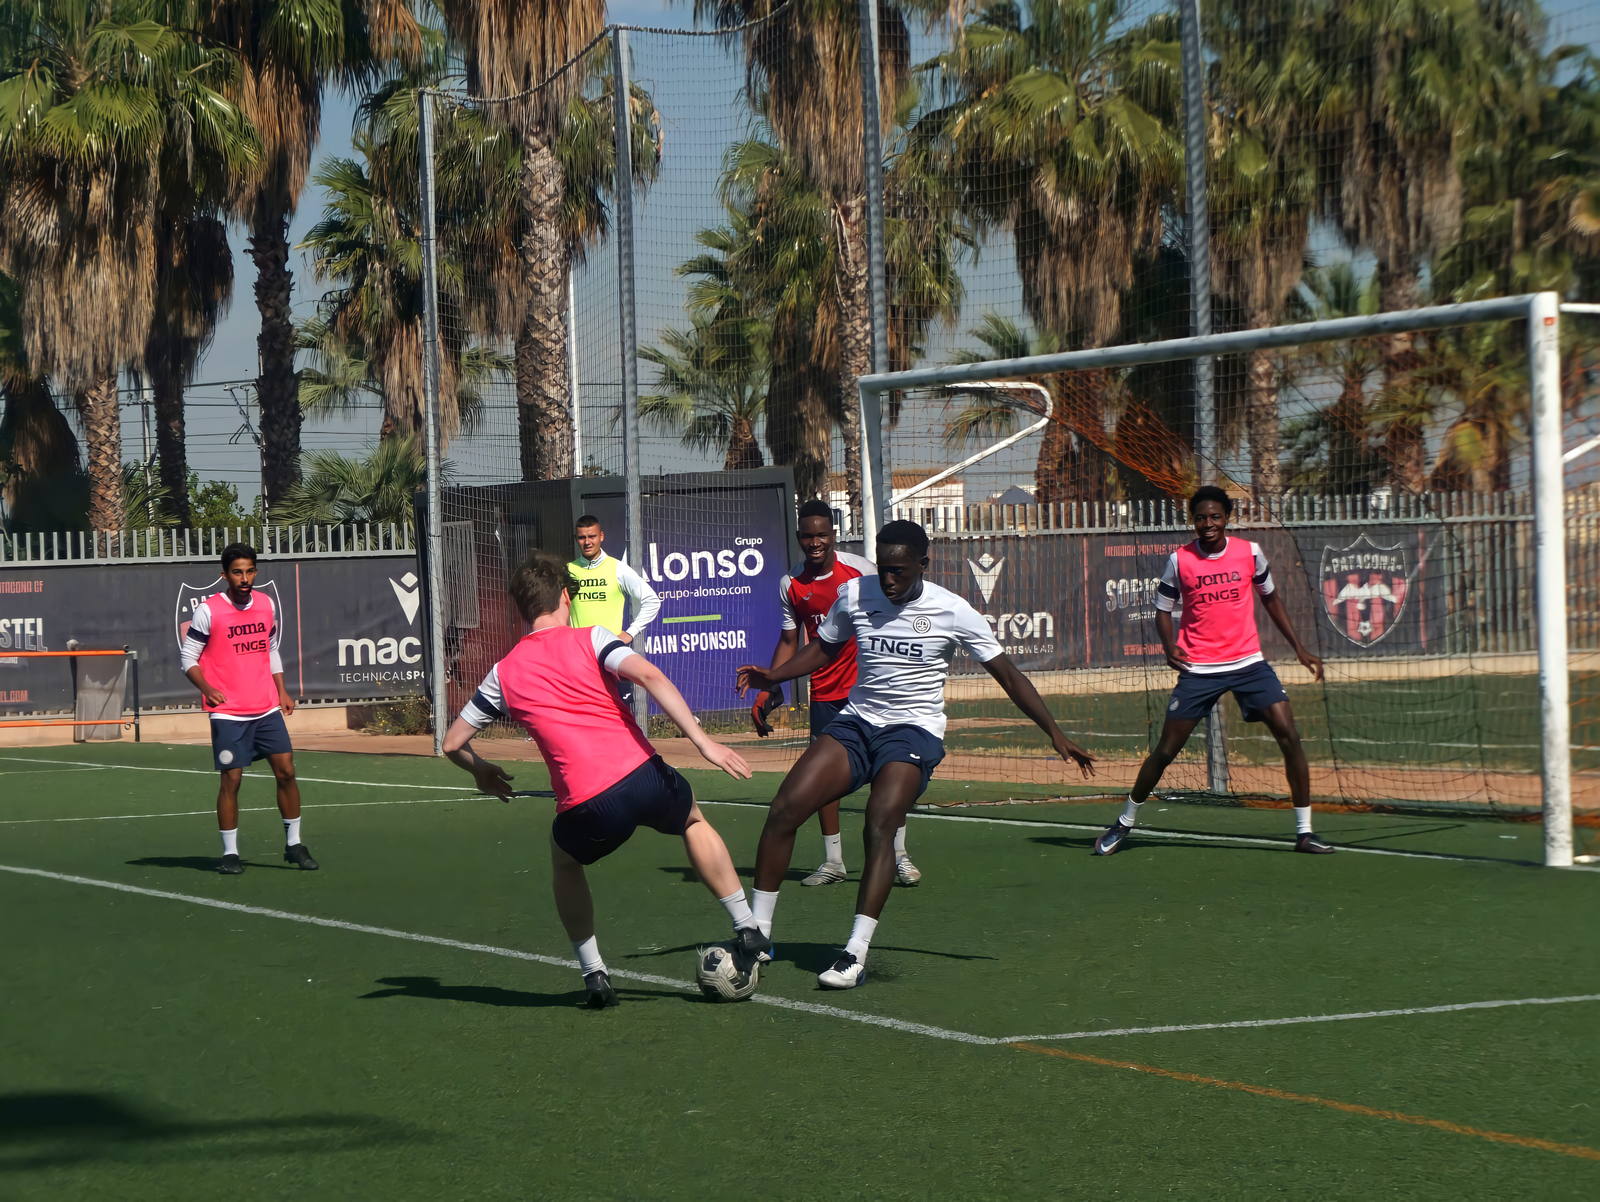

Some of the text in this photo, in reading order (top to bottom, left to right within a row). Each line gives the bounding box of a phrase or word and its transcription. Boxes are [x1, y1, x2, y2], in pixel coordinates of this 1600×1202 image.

[735, 537, 763, 547] Grupo
[0, 581, 32, 593] TACONA
[579, 578, 608, 588] oma
[577, 592, 607, 600] TNGS
[658, 586, 751, 600] grupo-alonso.com
[1198, 588, 1239, 603] TNGS
[233, 640, 266, 653] TNGS
[645, 630, 746, 654] MAIN SPONSOR
[868, 637, 924, 657] TNGS
[338, 636, 422, 666] mac
